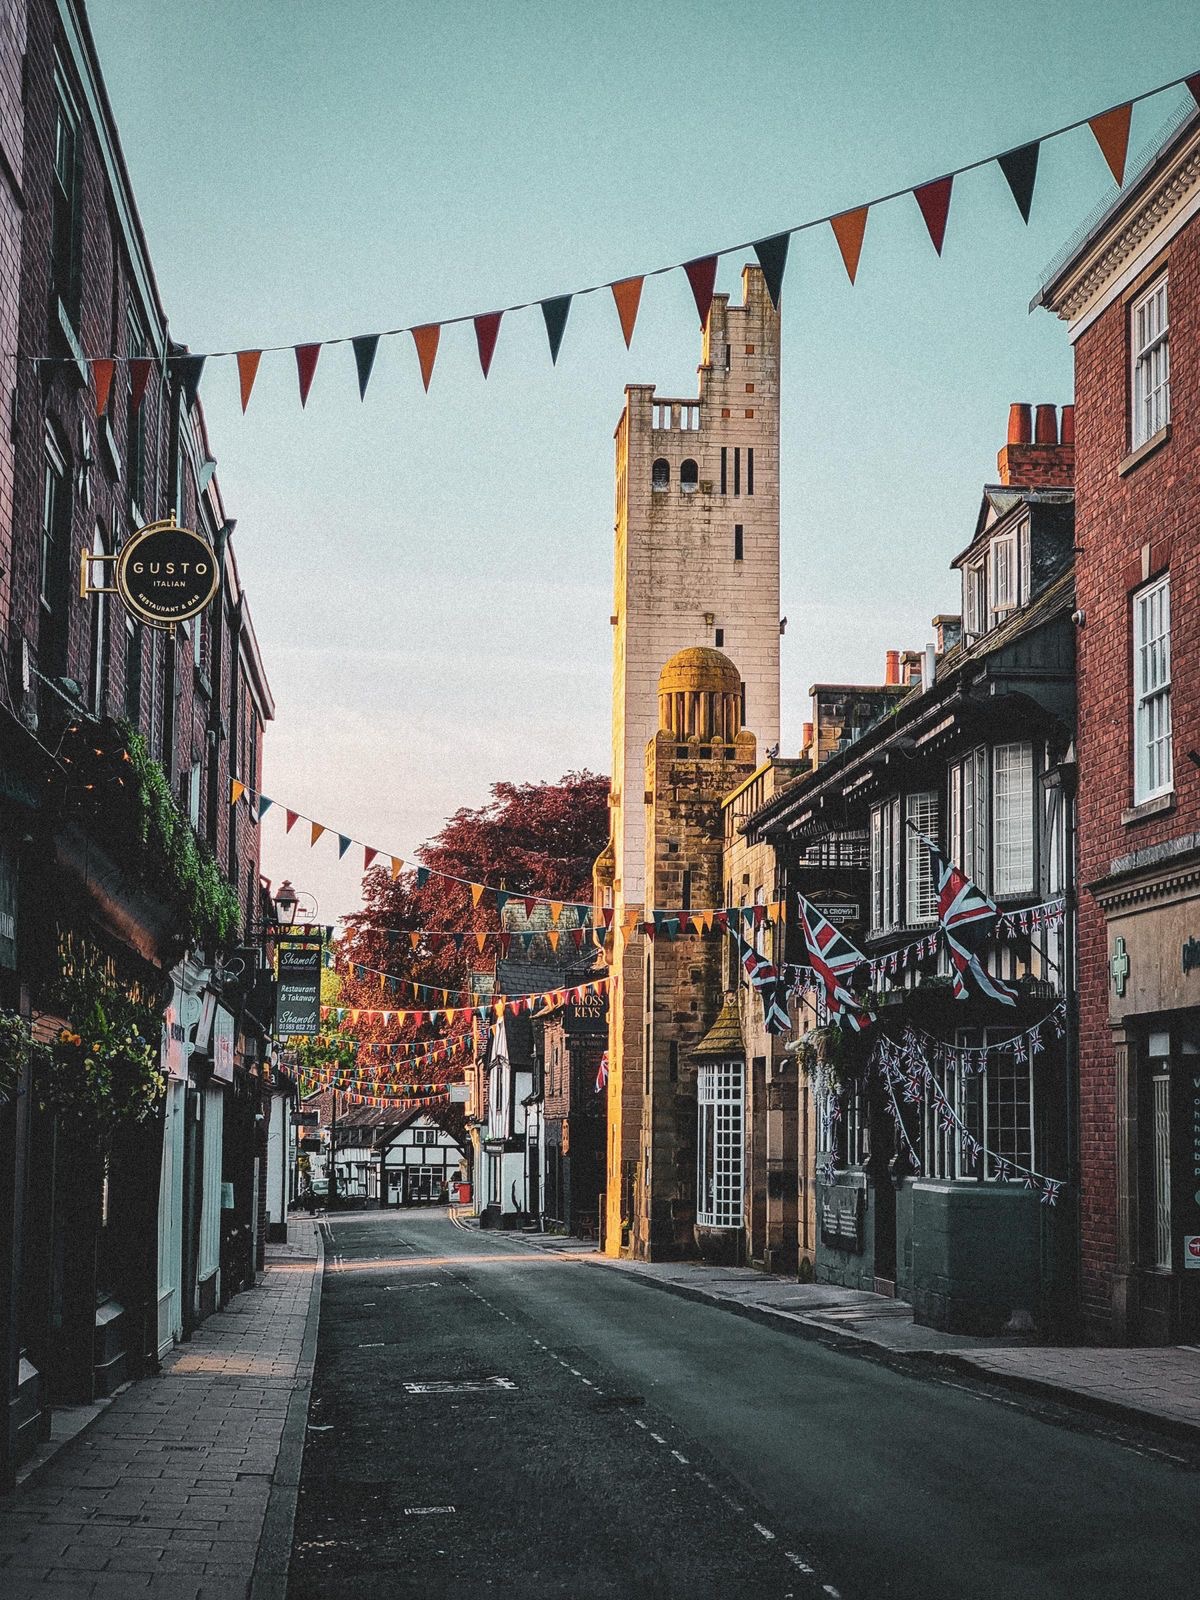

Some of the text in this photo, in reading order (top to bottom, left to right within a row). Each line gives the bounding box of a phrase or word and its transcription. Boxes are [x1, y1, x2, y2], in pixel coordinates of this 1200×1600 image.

[133, 562, 207, 575] GUSTO
[138, 593, 179, 612] RESTAURANT
[187, 594, 200, 606] BAR
[281, 952, 318, 965] Shamoli
[281, 985, 316, 993] Restaurant
[281, 993, 287, 1001] &
[571, 995, 604, 1006] CROSS
[280, 1010, 317, 1023] Shamoli
[574, 1007, 600, 1018] KEYS
